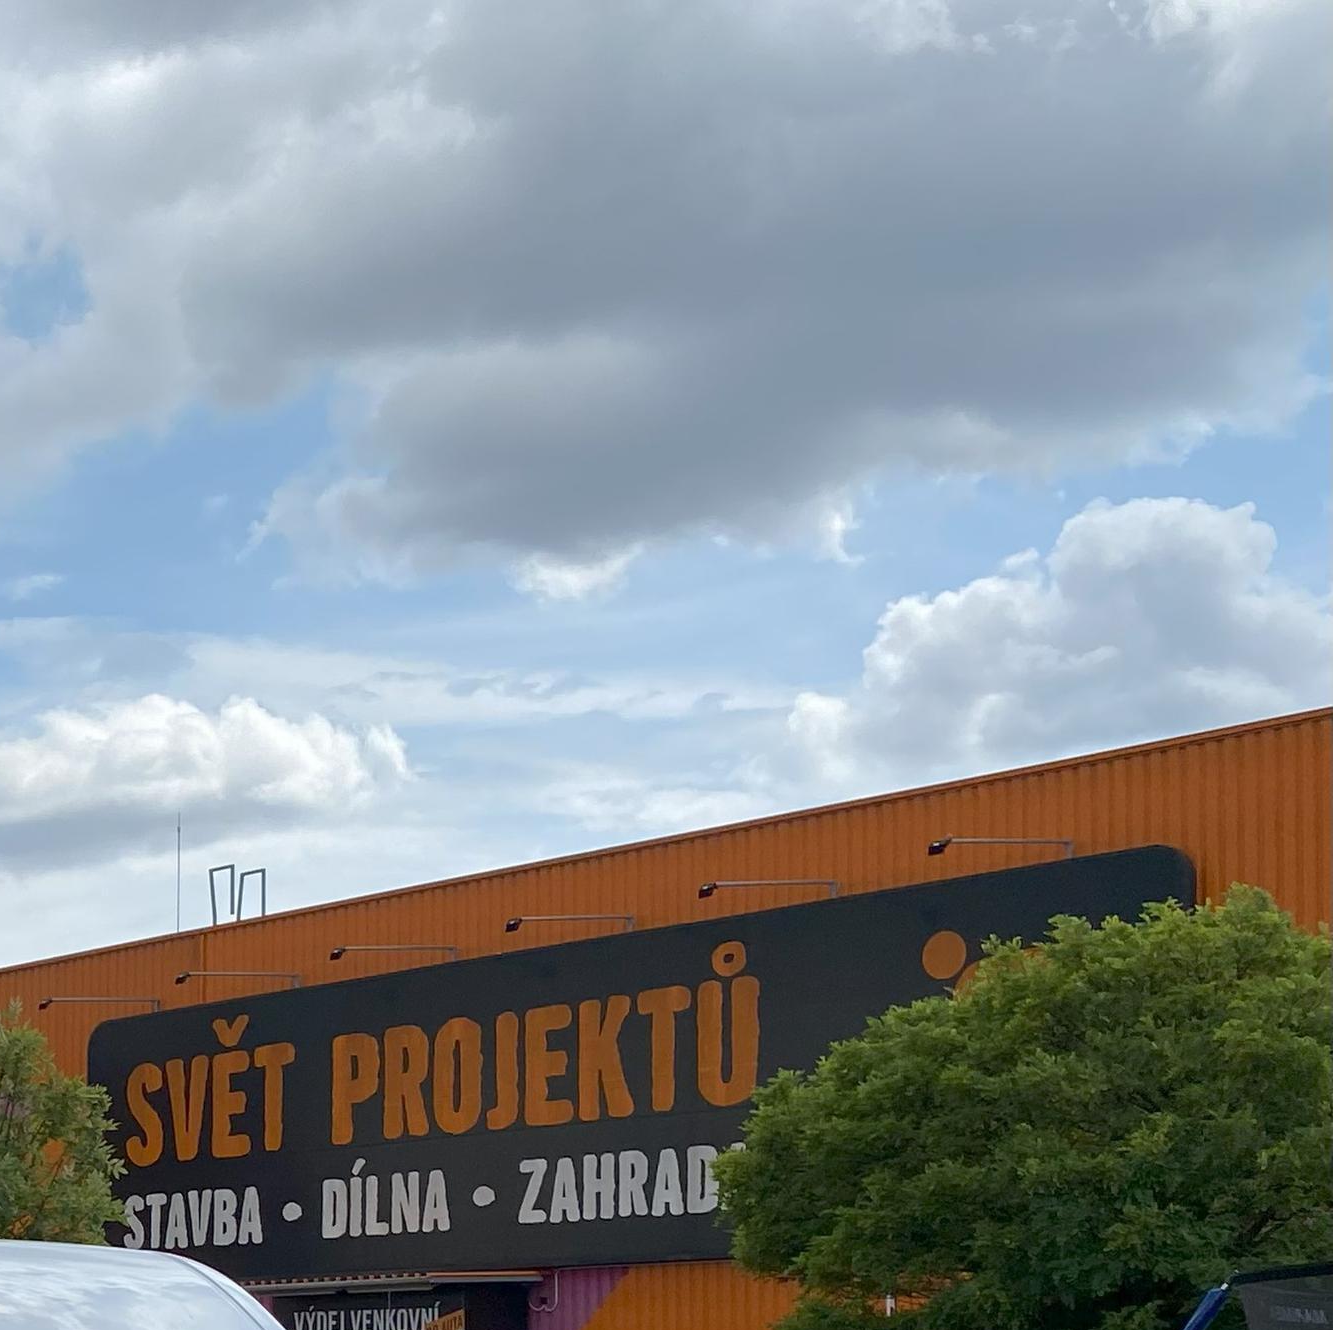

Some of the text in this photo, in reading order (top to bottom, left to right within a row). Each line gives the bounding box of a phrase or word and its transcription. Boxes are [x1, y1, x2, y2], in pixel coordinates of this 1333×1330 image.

[125, 941, 761, 1167] SVĚT PROJEKTŮ
[123, 1142, 747, 1250] STAVBA DÍLNA ZAHRAD
